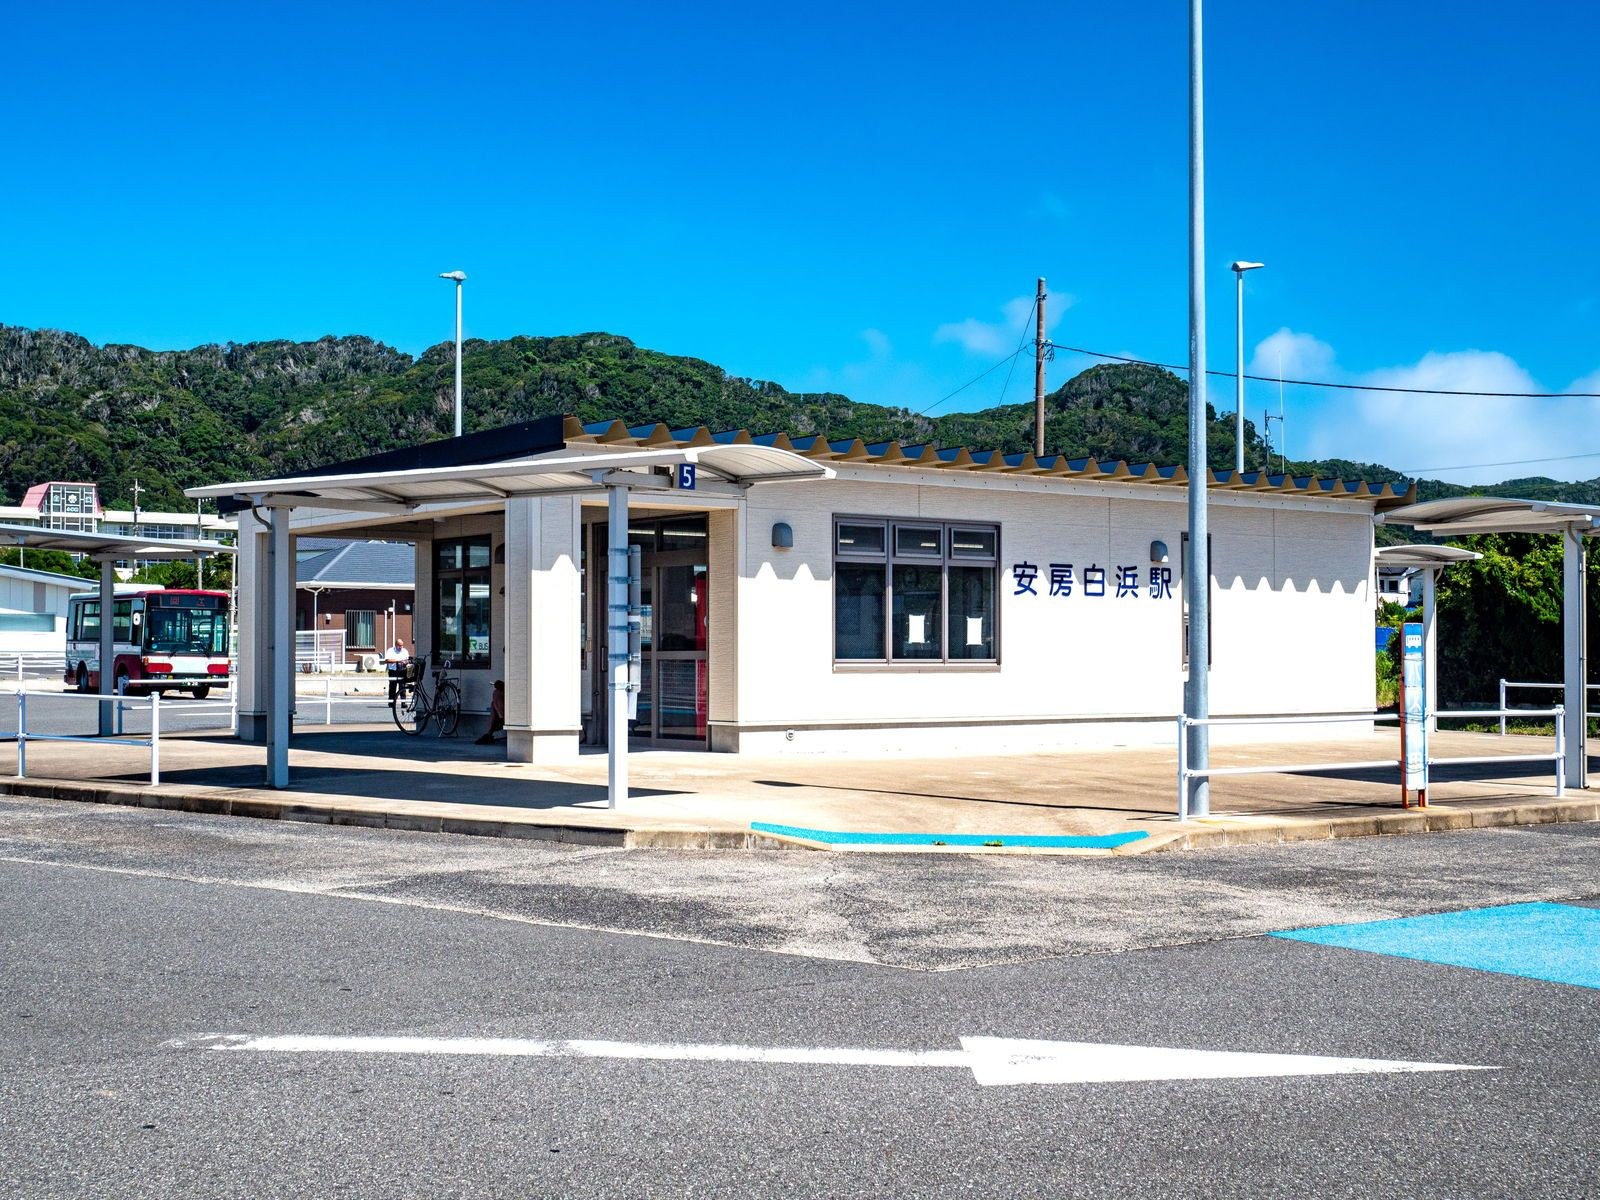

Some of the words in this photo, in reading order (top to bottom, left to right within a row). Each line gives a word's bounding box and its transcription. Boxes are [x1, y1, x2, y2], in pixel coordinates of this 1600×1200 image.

[683, 466, 692, 487] 5
[1013, 561, 1172, 599] 安房白浜駅
